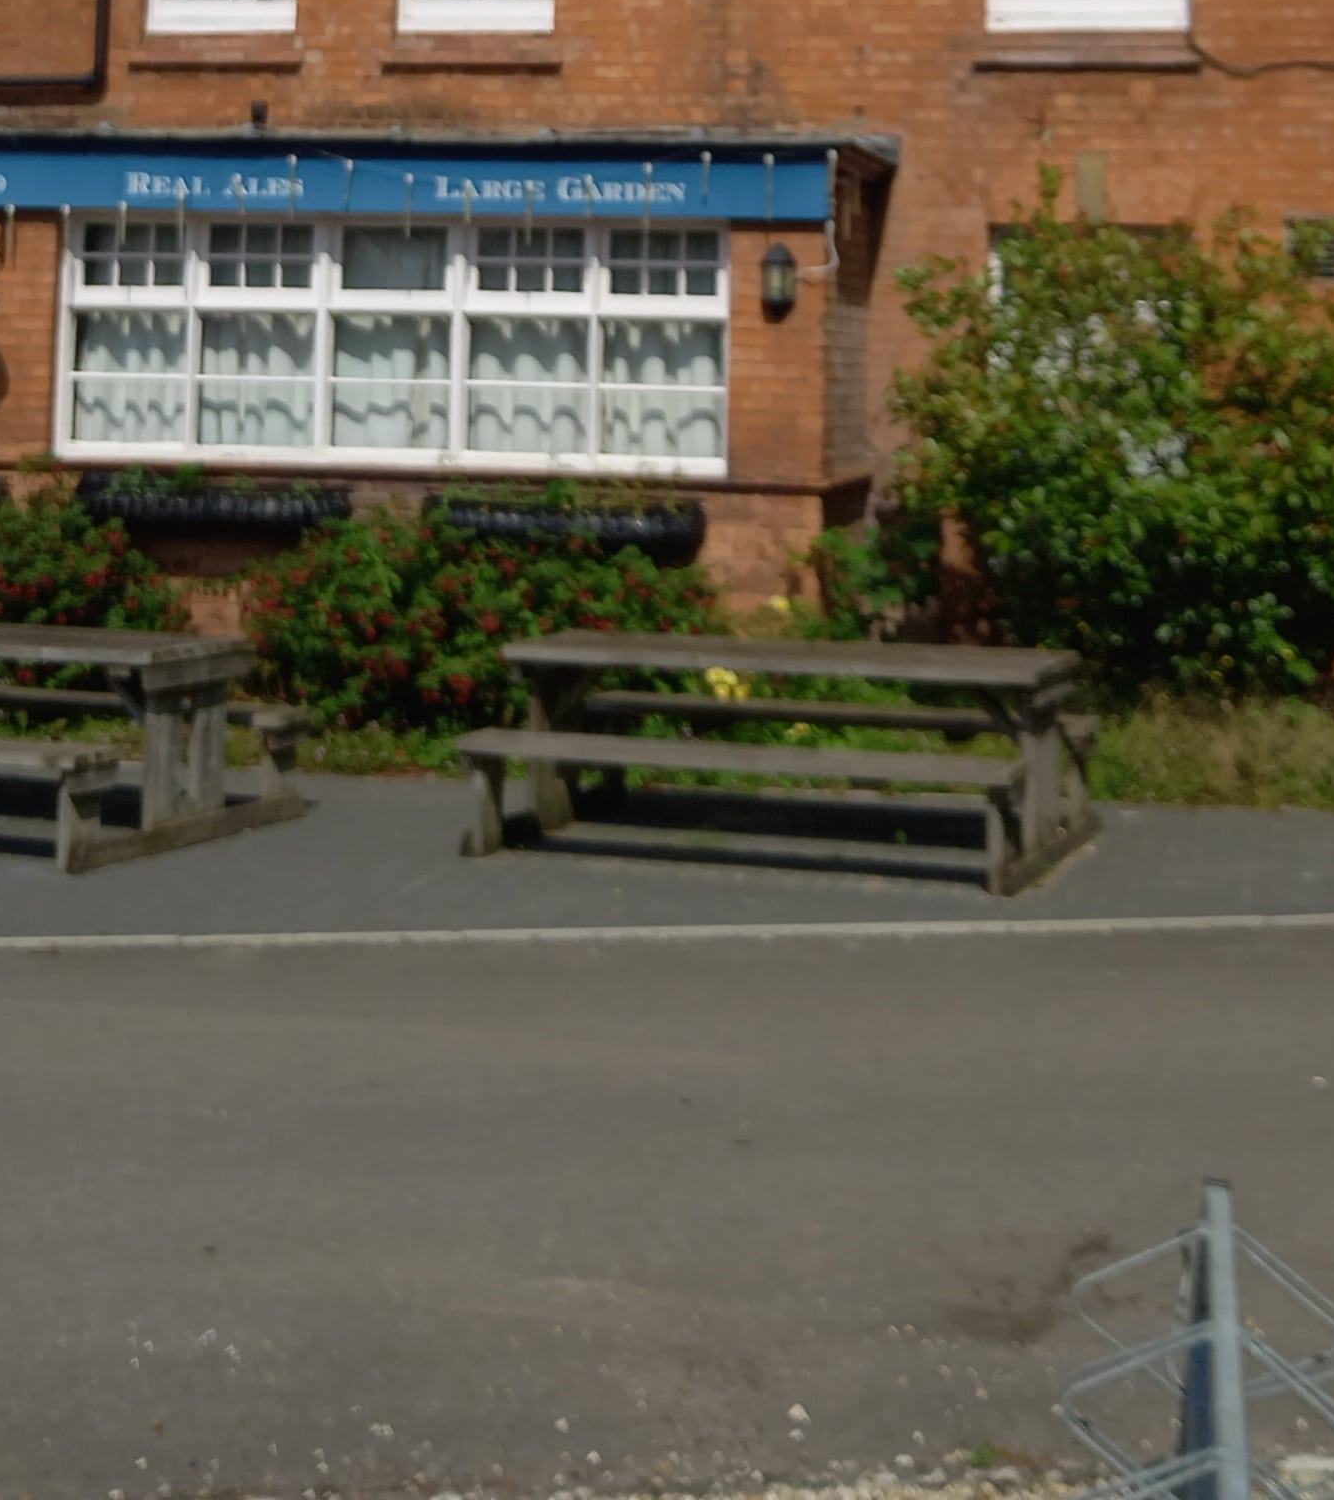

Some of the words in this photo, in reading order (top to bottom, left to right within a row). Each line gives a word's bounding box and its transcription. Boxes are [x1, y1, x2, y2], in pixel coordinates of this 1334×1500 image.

[126, 171, 212, 197] REAL
[222, 172, 305, 198] ALES
[435, 174, 546, 200] LARGE
[557, 175, 687, 202] GARDEN
